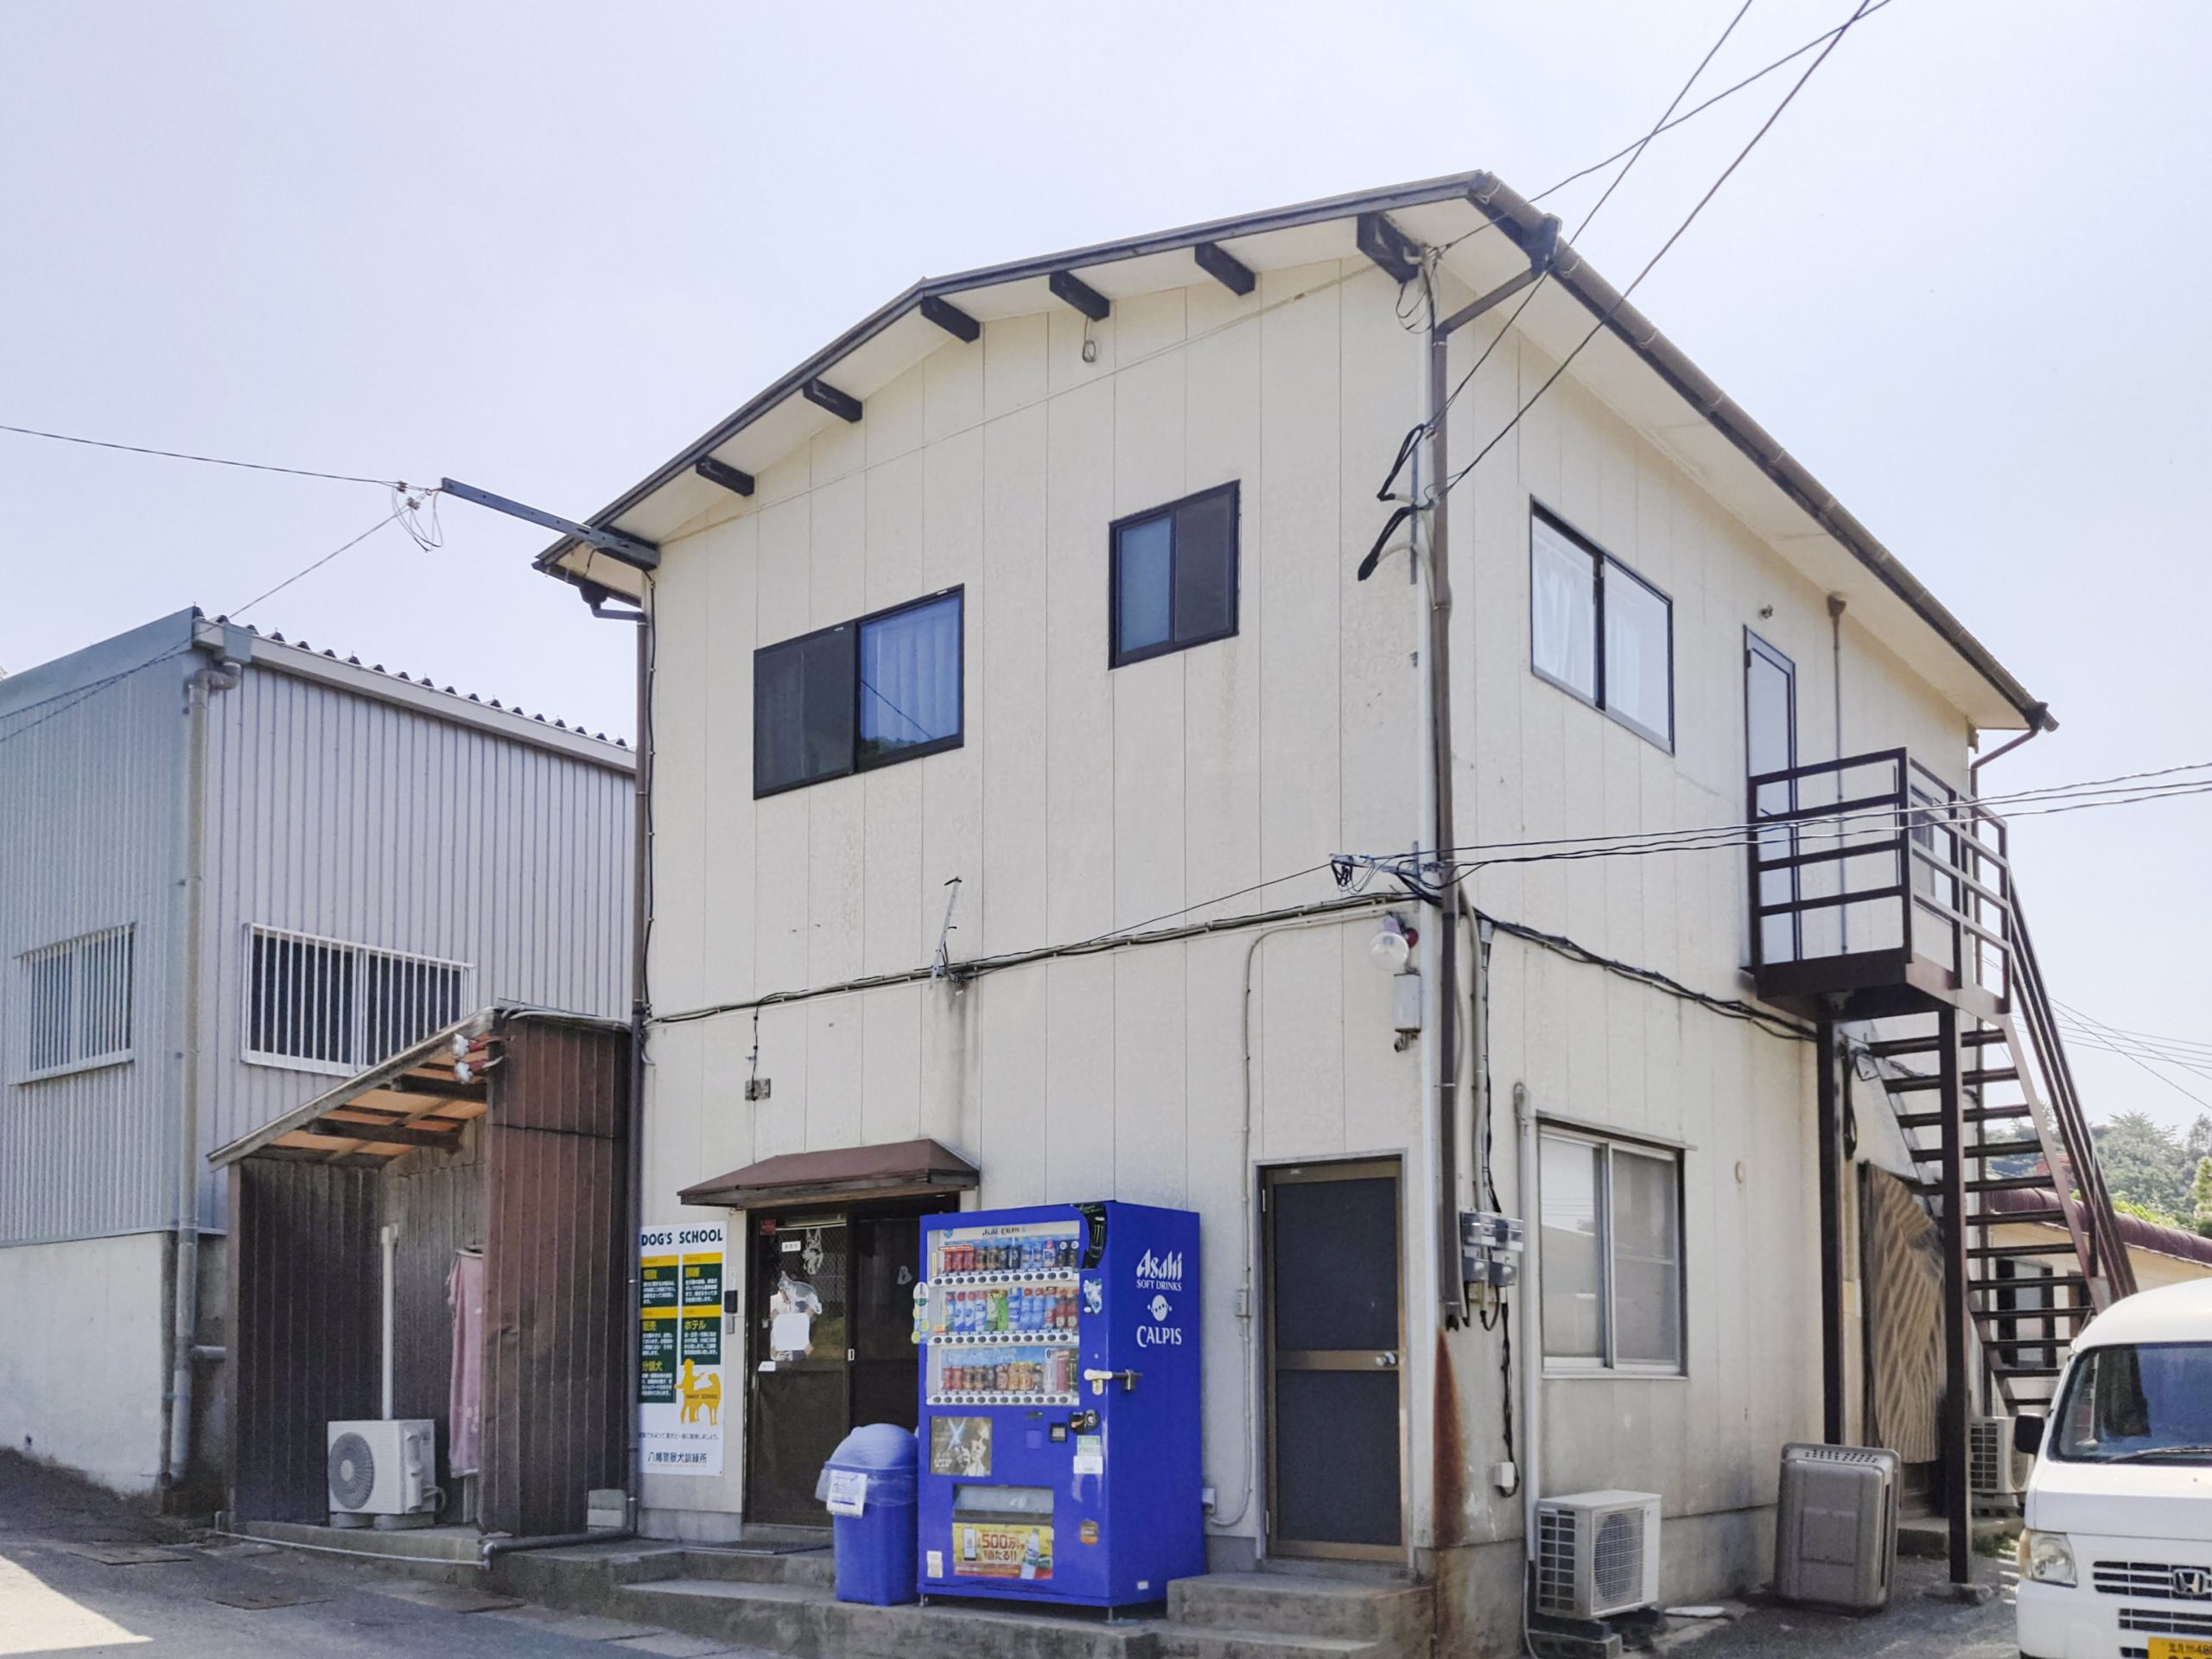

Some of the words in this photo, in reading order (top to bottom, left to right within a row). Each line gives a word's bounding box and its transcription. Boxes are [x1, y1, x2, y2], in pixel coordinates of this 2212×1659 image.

[641, 1232, 672, 1246] DOG'S
[679, 1229, 723, 1244] SCHOOL
[1136, 1249, 1182, 1281] Asahi
[1136, 1280, 1154, 1289] SOFT
[1156, 1281, 1182, 1292] DRINKS
[684, 1320, 707, 1330] ホテル
[1136, 1325, 1182, 1348] CALPIS
[647, 1452, 708, 1464] 八幡警察犬訓練所
